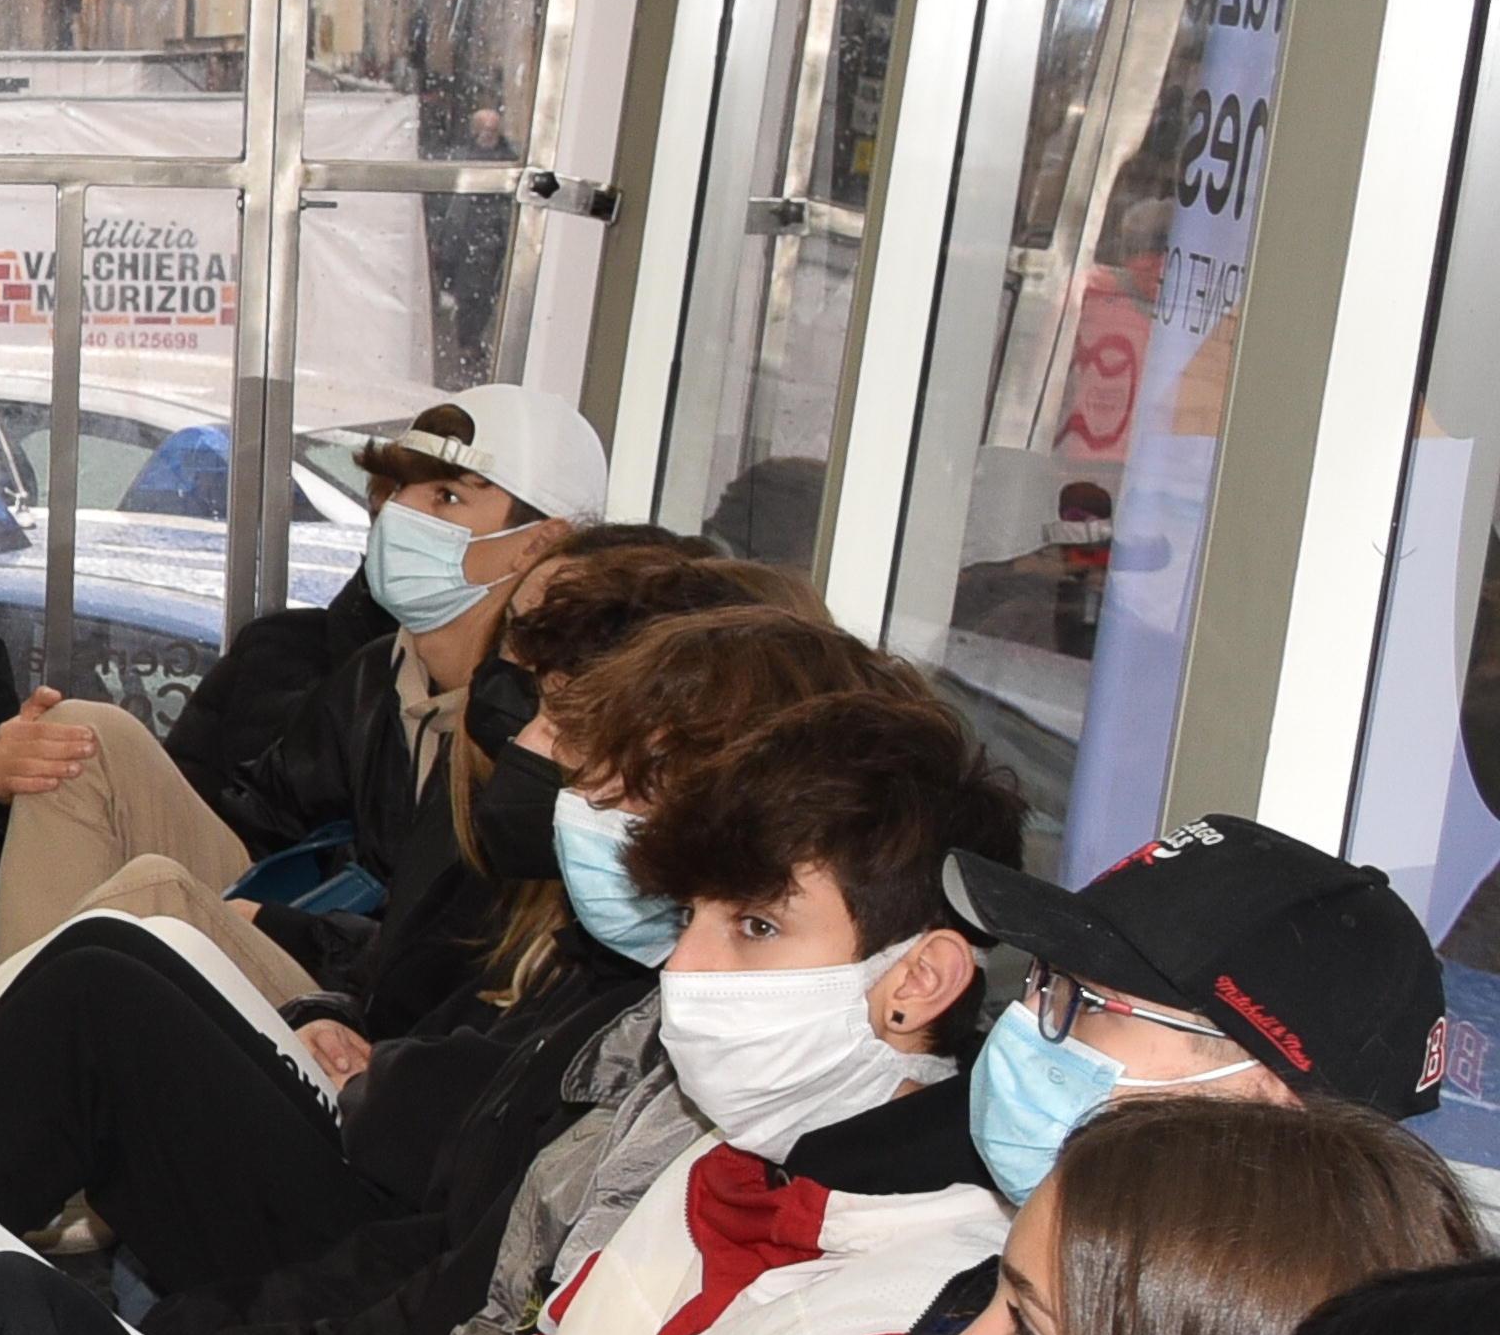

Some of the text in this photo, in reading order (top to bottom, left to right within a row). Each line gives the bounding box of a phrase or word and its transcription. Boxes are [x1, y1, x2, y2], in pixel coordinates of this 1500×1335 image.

[84, 217, 199, 249] dilizia
[25, 251, 238, 283] VCHIERA
[115, 332, 199, 350] 6125698
